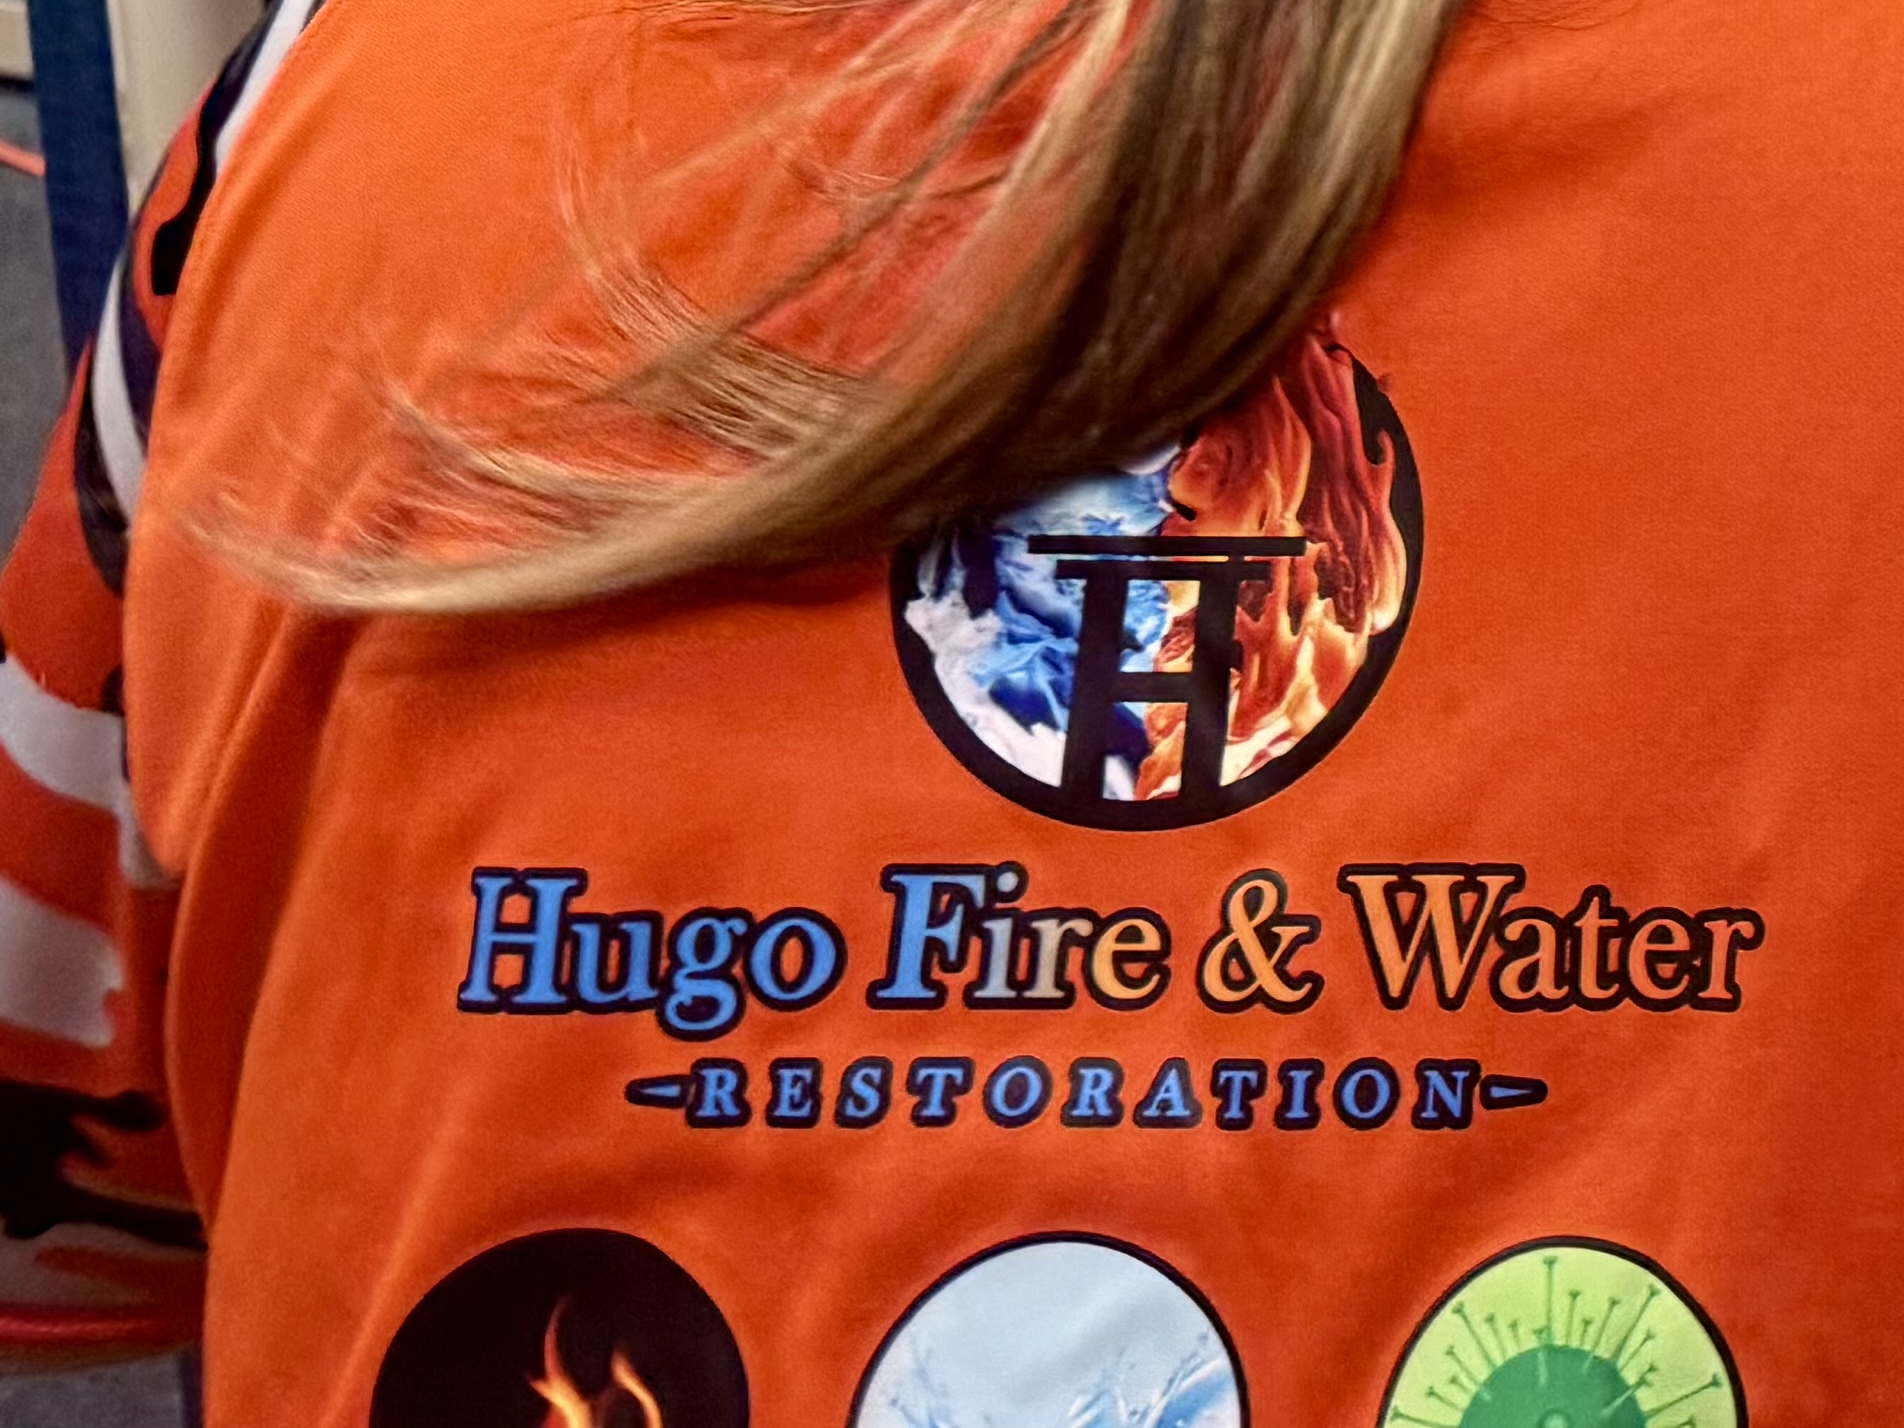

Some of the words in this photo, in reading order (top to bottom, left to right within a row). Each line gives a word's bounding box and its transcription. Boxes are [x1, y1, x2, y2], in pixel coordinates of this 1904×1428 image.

[456, 865, 848, 1044] Hugo
[864, 860, 1172, 1012] Fire
[1196, 867, 1326, 1016] &
[1337, 861, 1766, 1014] Water
